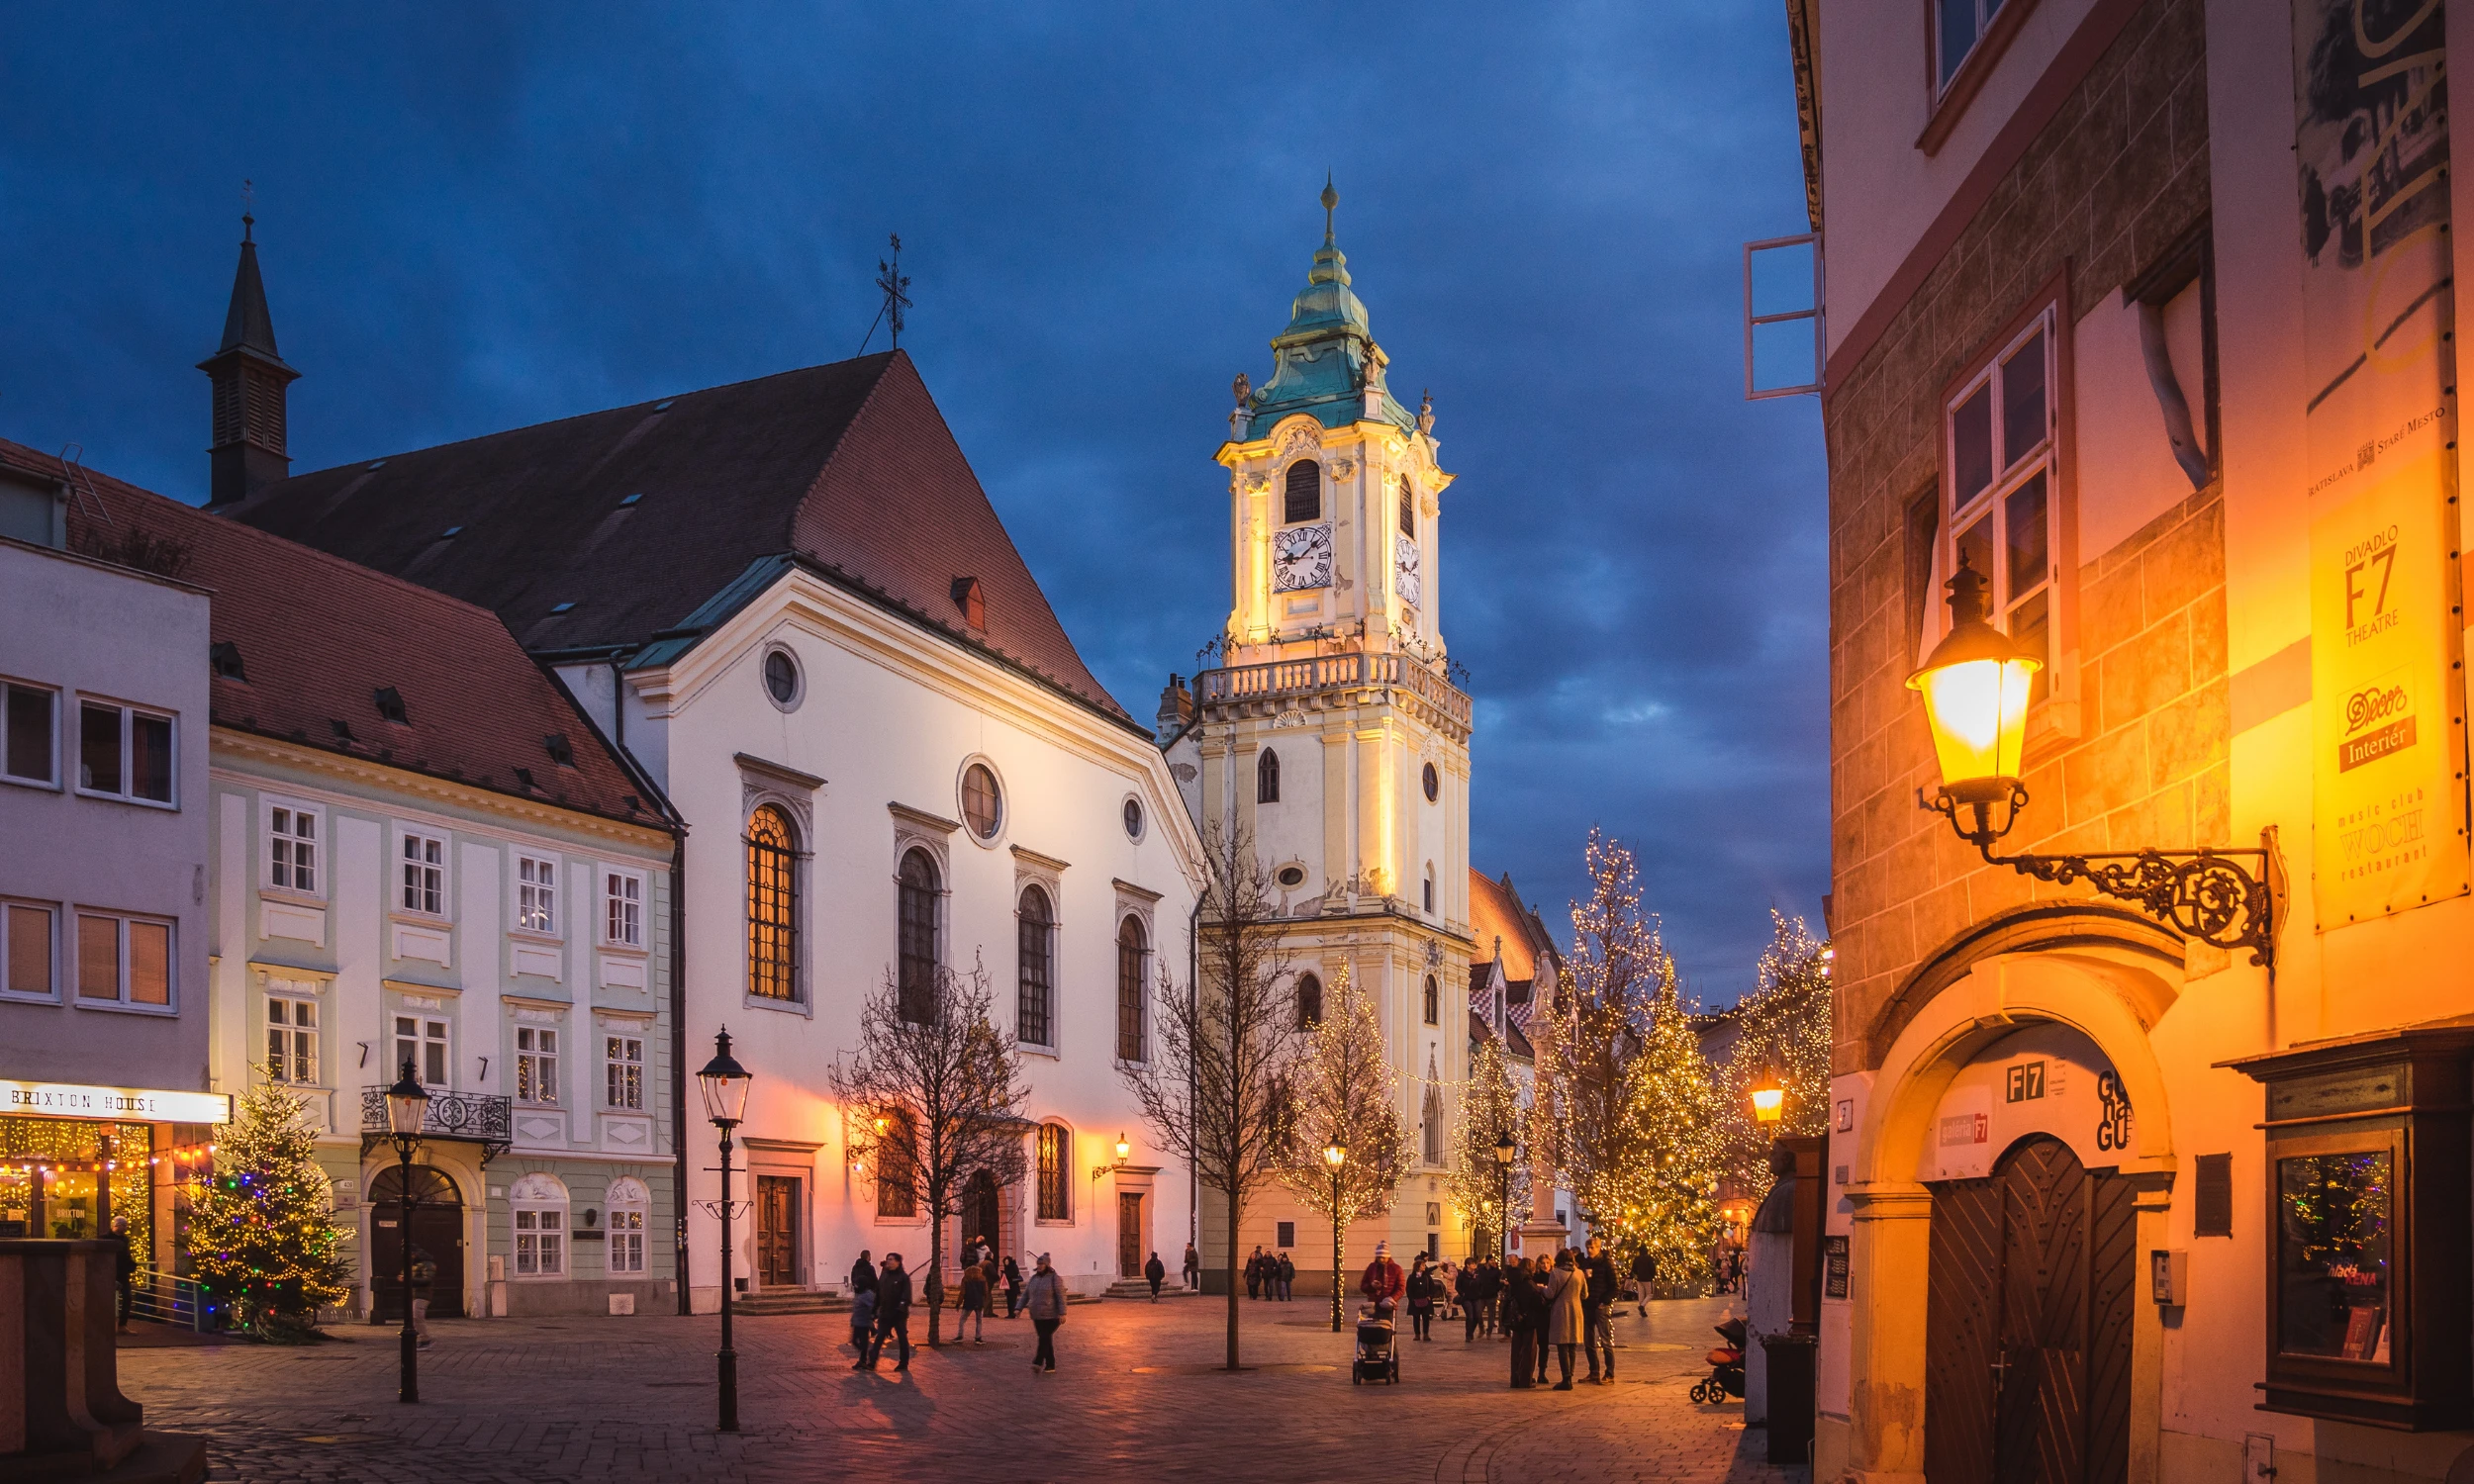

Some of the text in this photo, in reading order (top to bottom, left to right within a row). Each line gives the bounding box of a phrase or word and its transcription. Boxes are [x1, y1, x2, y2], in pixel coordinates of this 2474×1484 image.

[2344, 524, 2399, 567] DIVADLO
[2344, 542, 2397, 631] F7
[2345, 607, 2400, 648] THEATRE
[2344, 685, 2408, 737] Decor
[2348, 725, 2407, 765] Interiér
[2337, 787, 2424, 828] music club
[2338, 808, 2425, 863] WOCH
[2340, 844, 2427, 882] restaurant
[11, 1089, 157, 1113] BRIXTON HOUSE
[2009, 1066, 2043, 1100] F7
[1942, 1119, 1987, 1143] galéria F7
[2097, 1119, 2128, 1152] GU
[56, 1209, 85, 1218] BRIXTON
